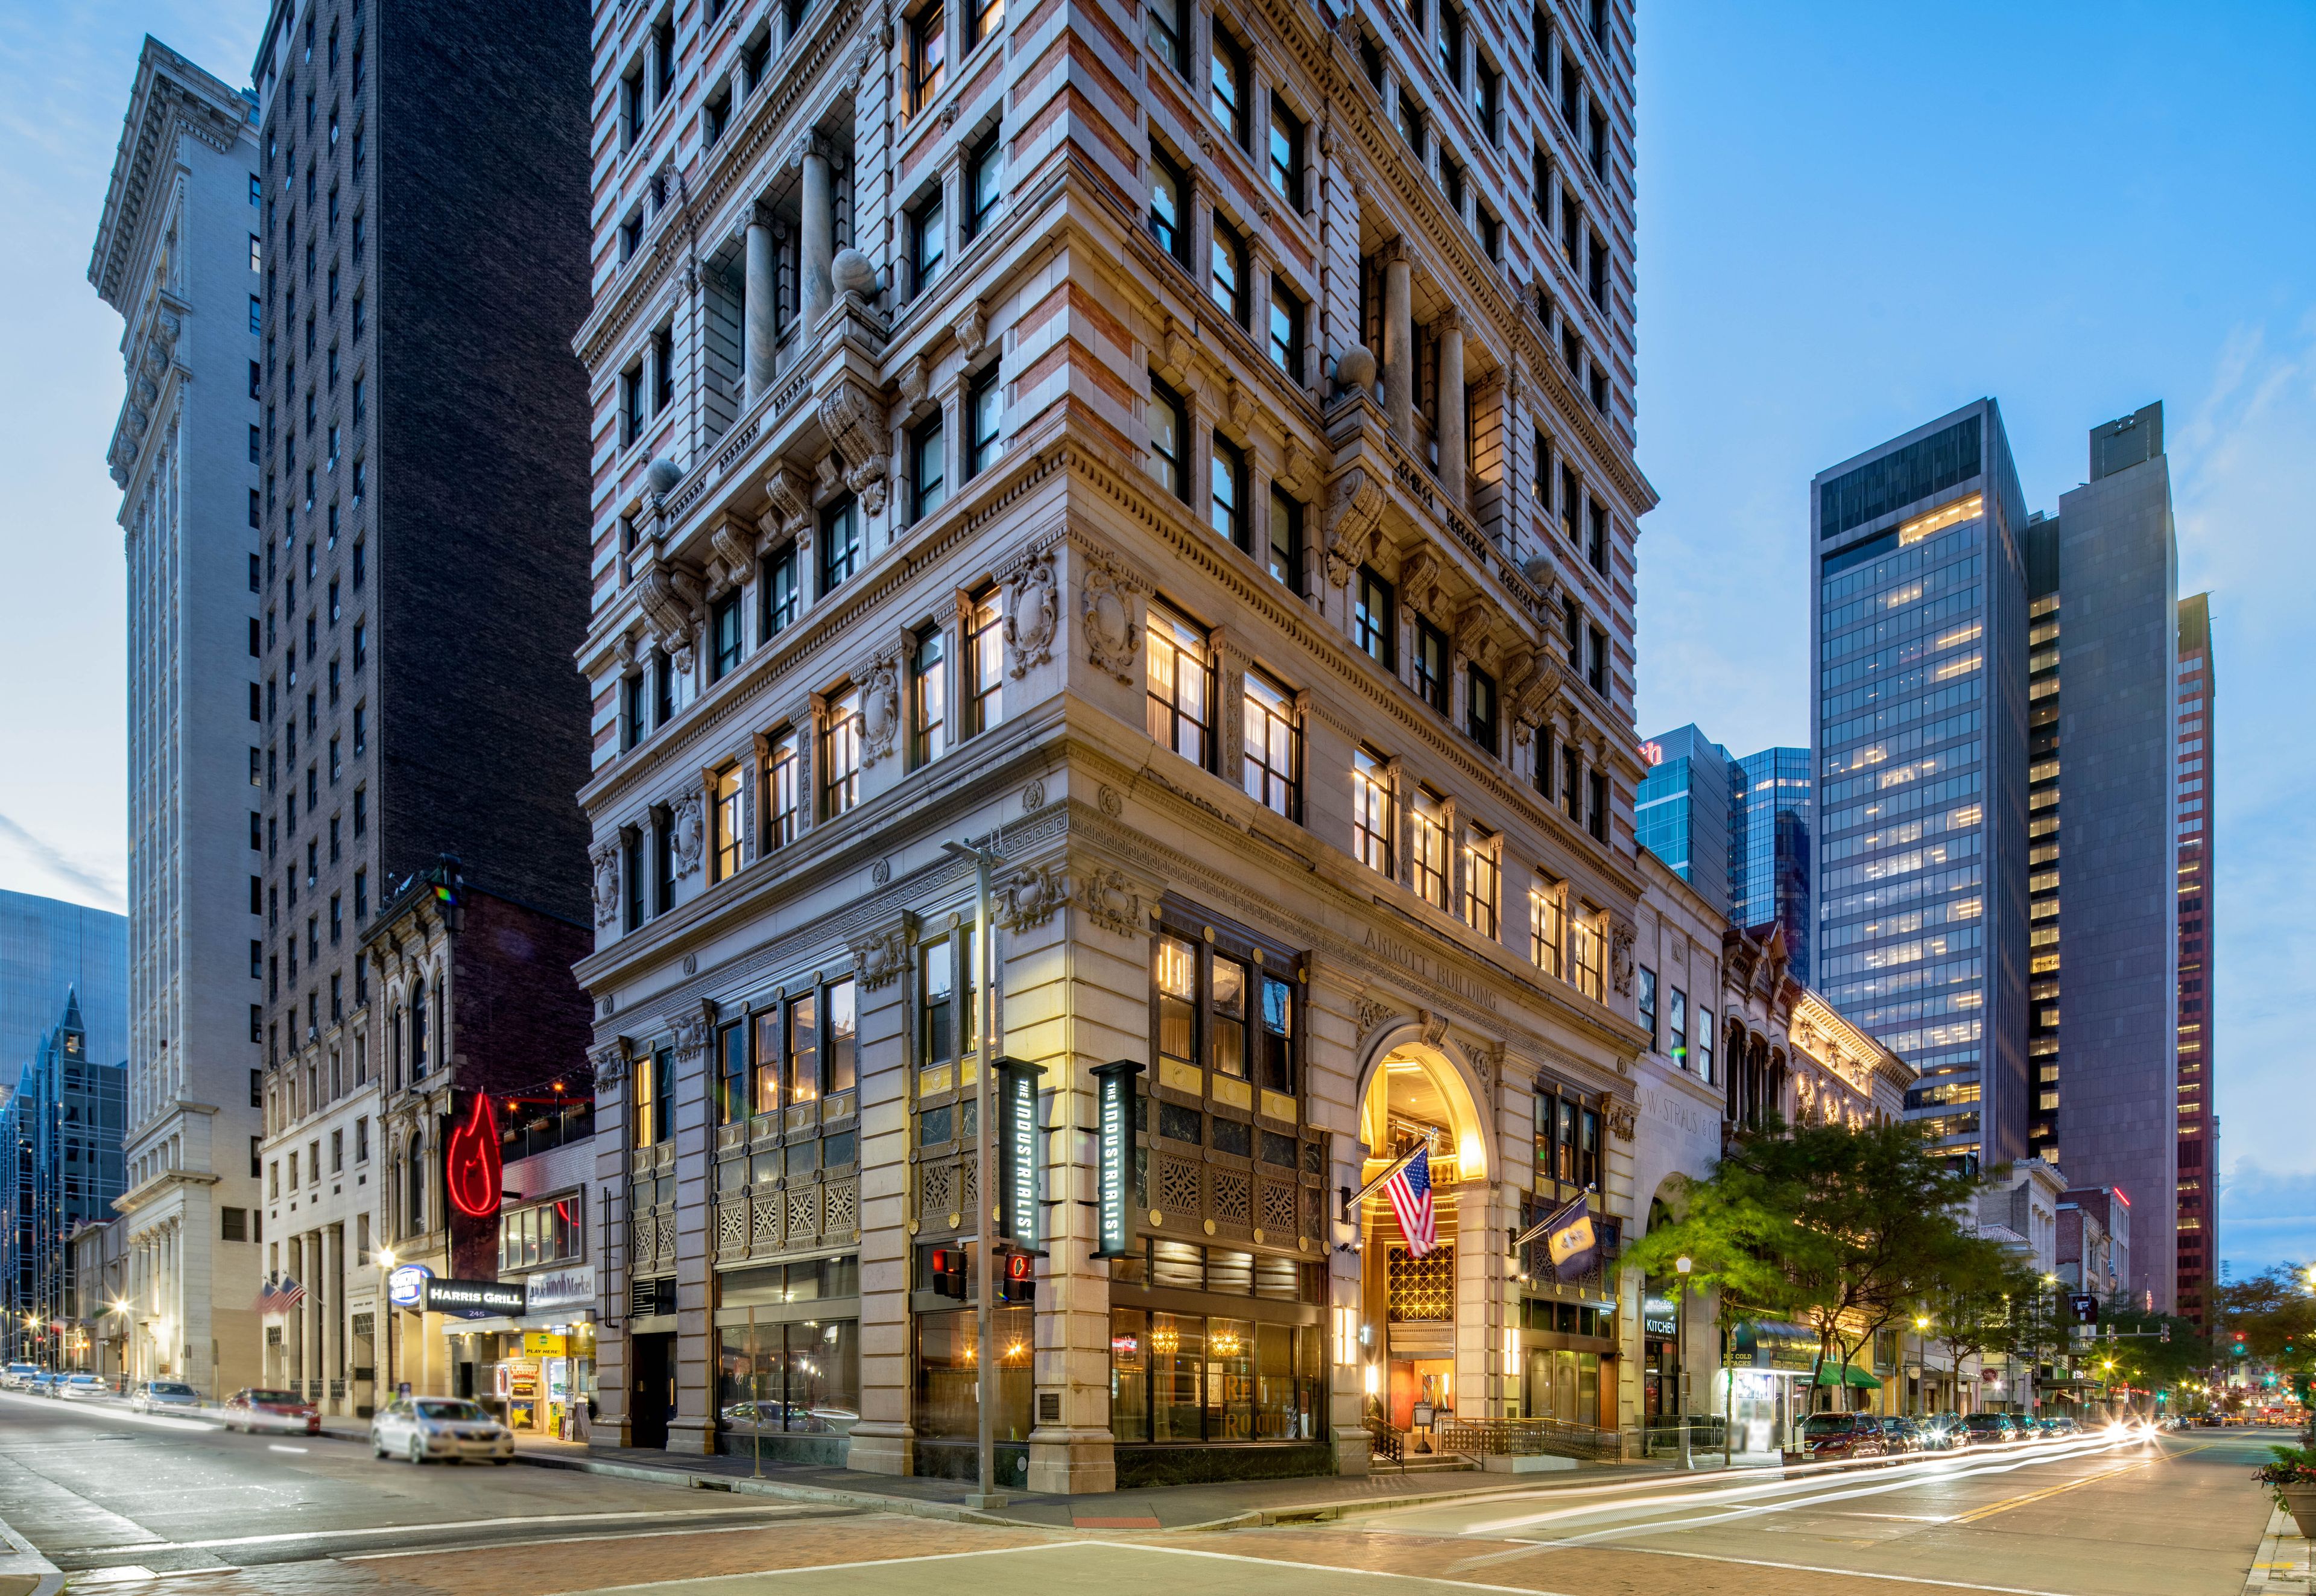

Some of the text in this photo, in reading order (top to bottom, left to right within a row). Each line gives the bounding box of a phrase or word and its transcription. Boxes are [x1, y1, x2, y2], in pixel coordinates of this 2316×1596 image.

[1364, 927, 1496, 1012] ARROTT BUILDING
[1663, 1098, 1697, 1134] STRAUS
[1702, 1119, 1707, 1136] &
[1708, 1121, 1720, 1144] CO
[1016, 1080, 1032, 1239] THE INDUSTRIALIST
[1105, 1081, 1118, 1240] THE INDUSTRIALIST
[431, 1289, 522, 1305] HARRIS GRILL
[546, 1279, 566, 1297] WOOD
[567, 1275, 592, 1296] Market
[1647, 1319, 1675, 1334] KITCHEN
[1795, 1362, 1810, 1370] TOBACCO
[566, 1393, 574, 1402] EBT
